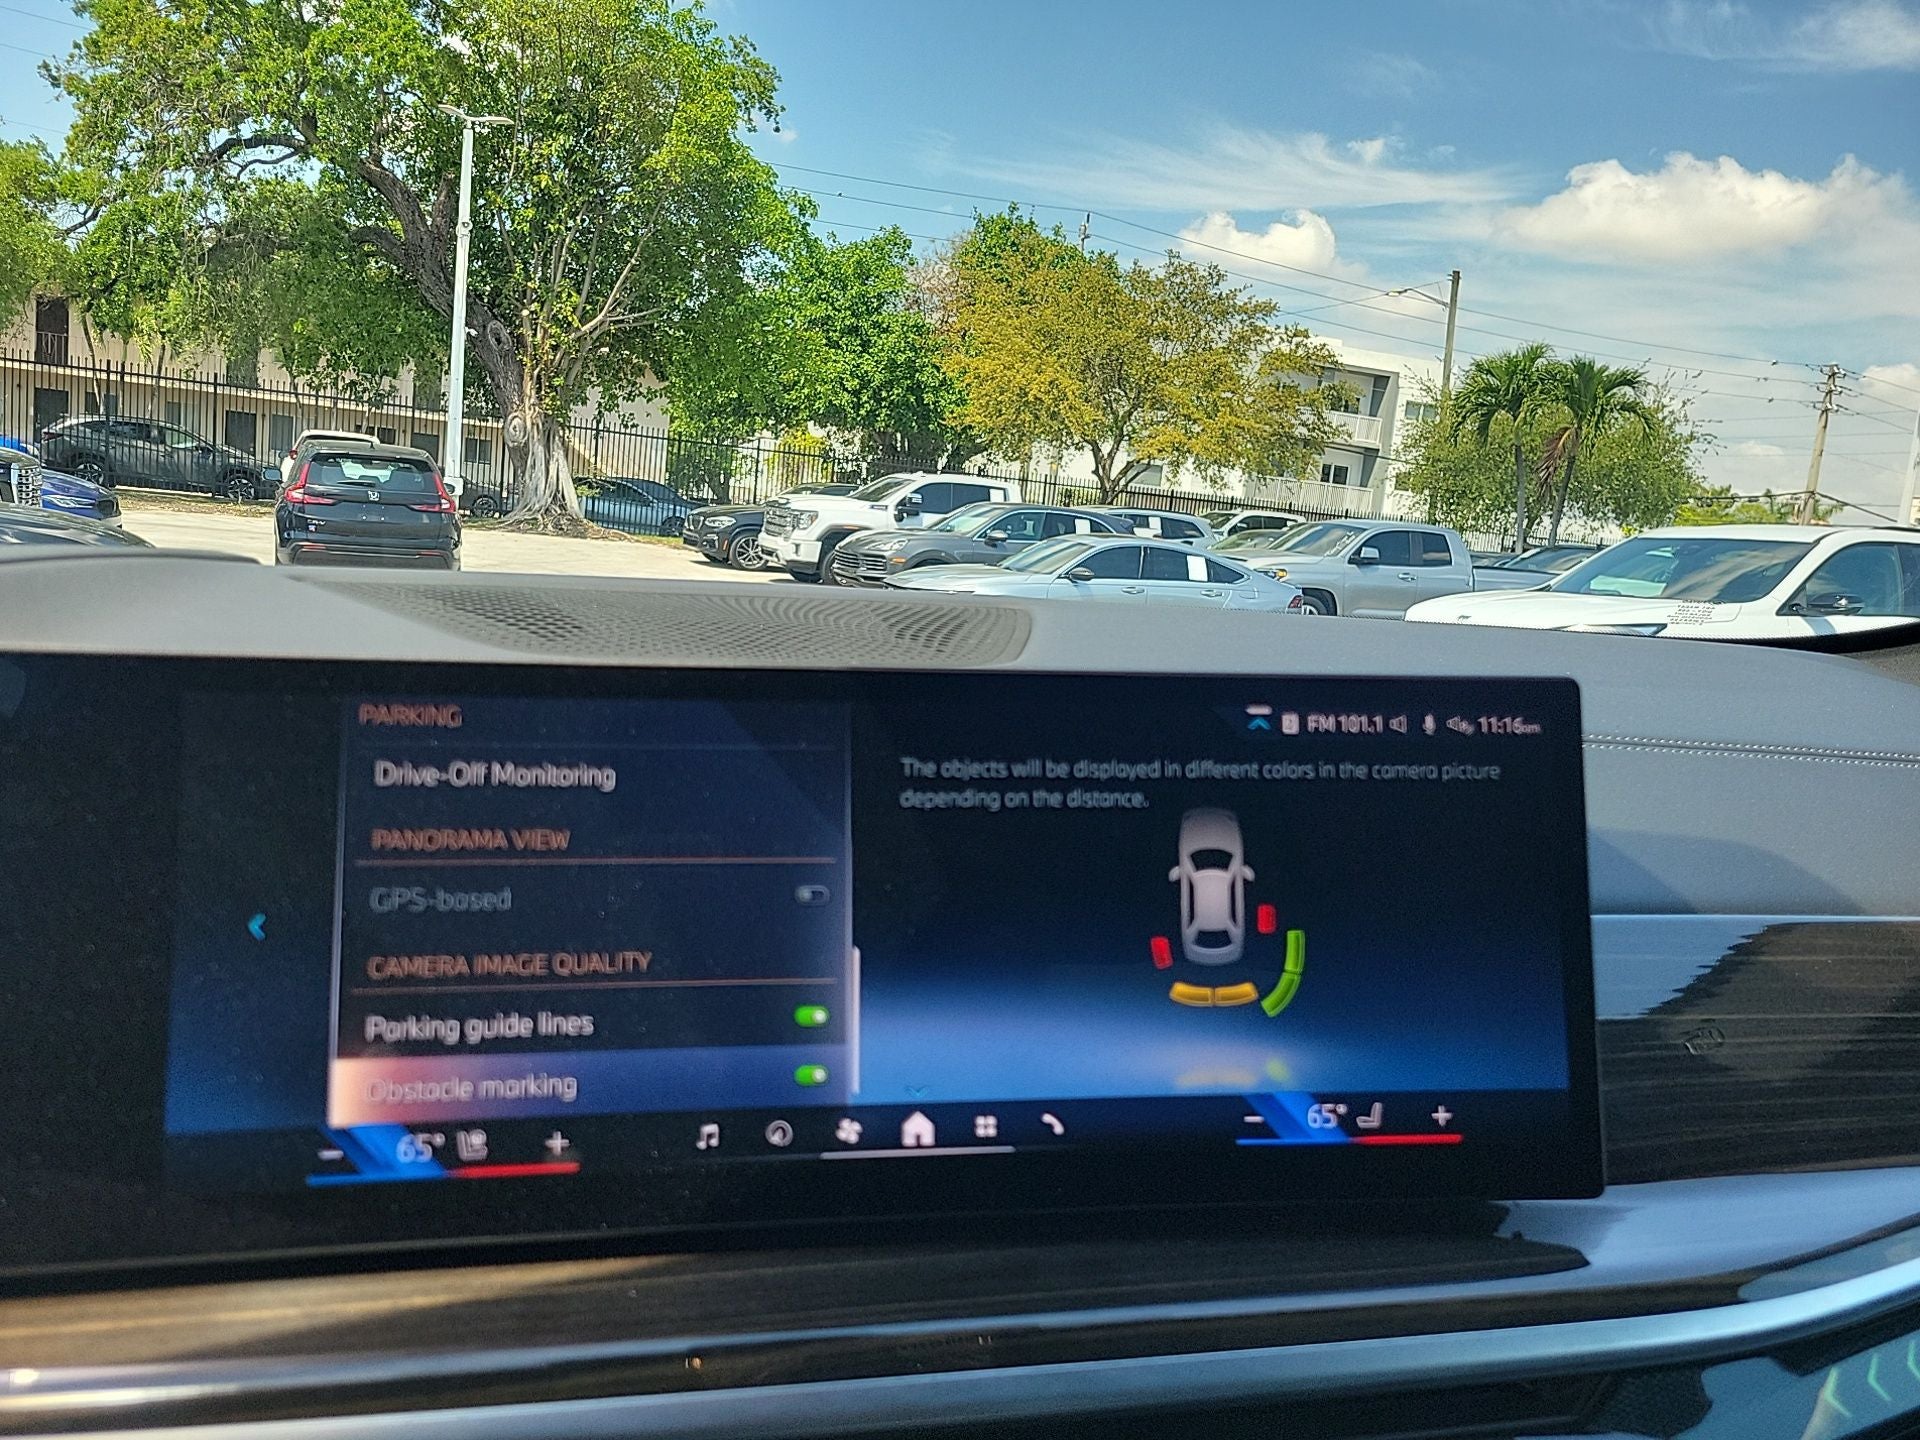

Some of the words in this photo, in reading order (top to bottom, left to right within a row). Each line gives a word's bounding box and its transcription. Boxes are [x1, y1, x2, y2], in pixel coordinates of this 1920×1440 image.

[358, 703, 463, 729] PARKING
[1307, 714, 1336, 733] FM
[1338, 714, 1383, 733] 101.1
[374, 760, 487, 788] Drive-Off
[491, 762, 617, 792] Monitoring
[900, 756, 937, 778] The
[940, 757, 1009, 781] objects
[1011, 758, 1042, 778] will
[1045, 760, 1070, 779] be
[1073, 759, 1161, 781] displayed
[1164, 760, 1182, 778] in
[1185, 758, 1259, 779] different
[1262, 761, 1315, 780] colors
[1318, 761, 1336, 779] in
[1339, 760, 1369, 780] the
[1371, 763, 1439, 780] camera
[1441, 760, 1501, 783] picture
[899, 788, 1001, 812] depending
[1003, 792, 1030, 808] on
[1032, 789, 1064, 808] the
[1066, 788, 1149, 809] distance.
[370, 829, 508, 851] PANORAMA
[510, 828, 571, 851] VIEW
[368, 886, 512, 914] GPS-based
[366, 956, 469, 980] CAMERA
[474, 953, 549, 977] IMAGE
[552, 951, 652, 976] QUALITY
[364, 1014, 461, 1046] Parking
[466, 1012, 534, 1042] guide
[537, 1011, 595, 1037] lines
[367, 1076, 475, 1103] Obstacle
[479, 1073, 578, 1103] marking
